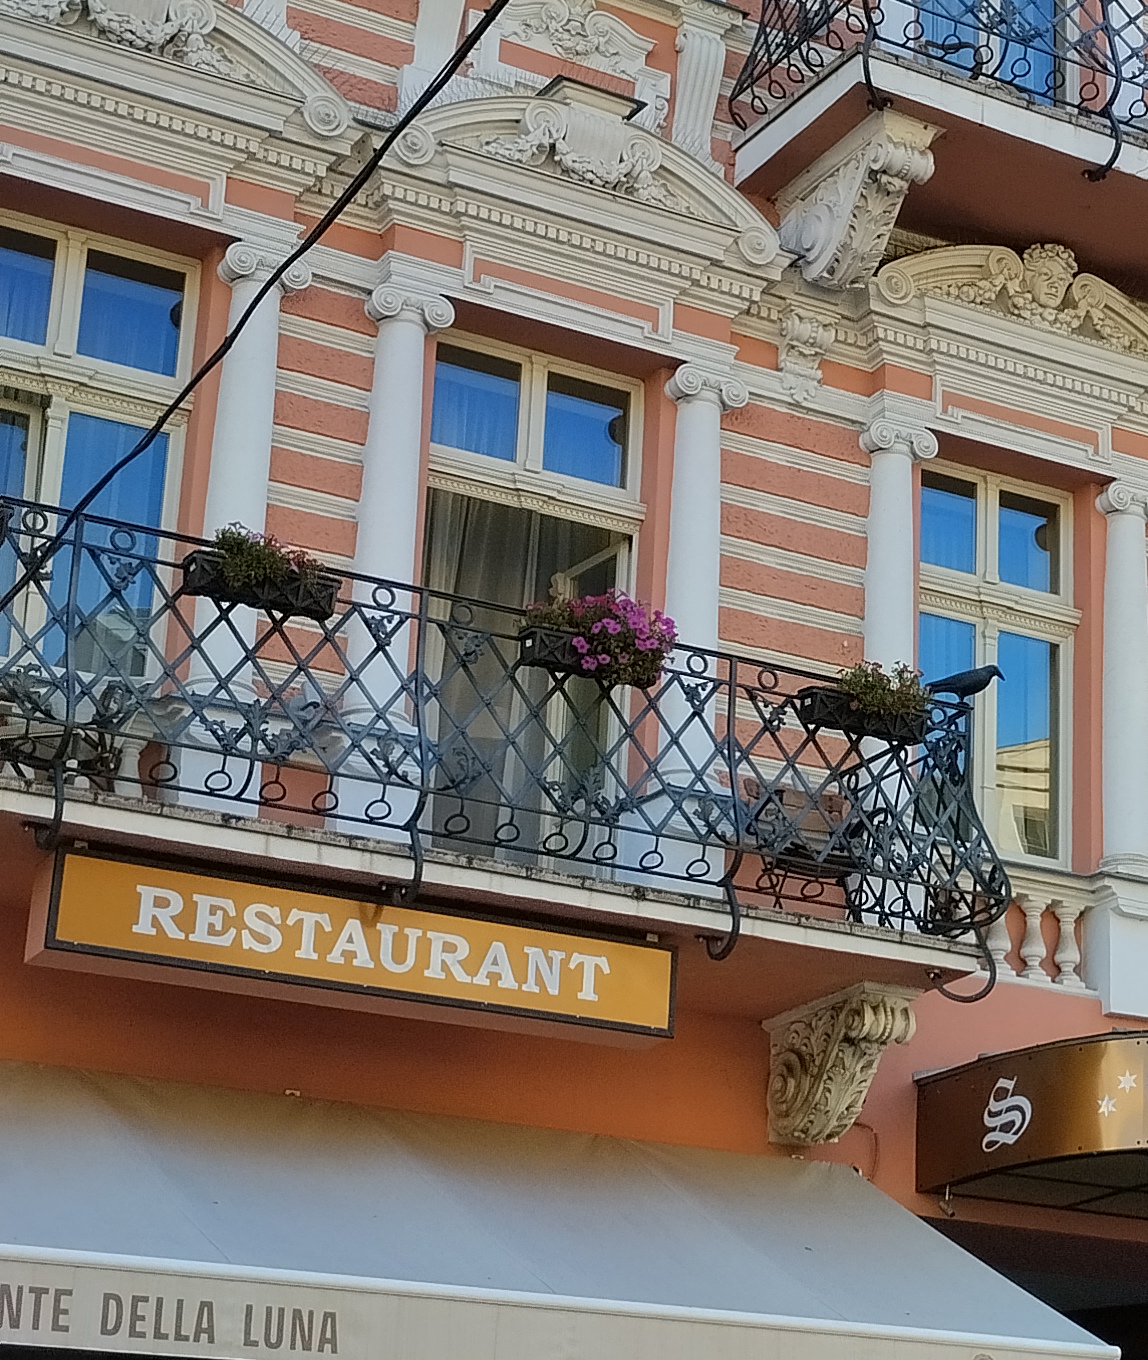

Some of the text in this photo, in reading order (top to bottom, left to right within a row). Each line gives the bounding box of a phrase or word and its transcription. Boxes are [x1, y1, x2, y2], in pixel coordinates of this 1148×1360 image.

[132, 884, 611, 1001] RESTAURANT
[100, 1292, 215, 1344] DELLA
[242, 1303, 338, 1354] LUNA
